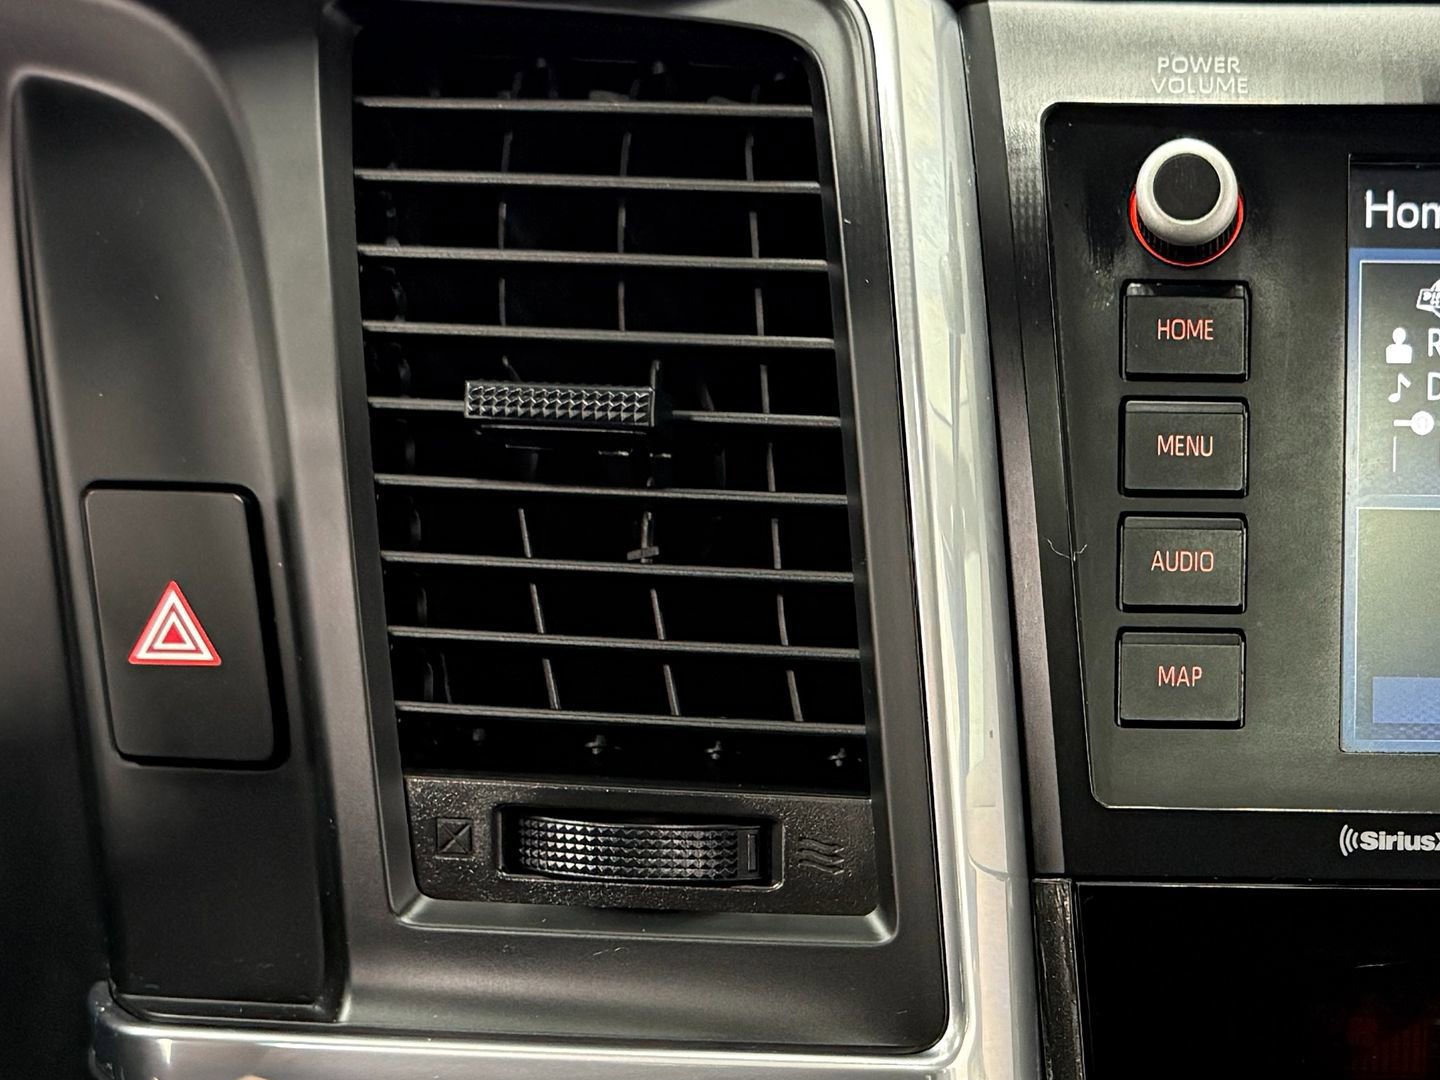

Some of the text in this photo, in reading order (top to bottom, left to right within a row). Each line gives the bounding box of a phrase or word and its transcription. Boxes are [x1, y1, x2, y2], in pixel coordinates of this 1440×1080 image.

[1157, 56, 1242, 74] POWER
[1150, 76, 1249, 95] VOLUME
[1157, 318, 1214, 341] HOME
[1157, 435, 1214, 458] MENU
[1150, 550, 1215, 573] AUDIO
[1158, 666, 1203, 687] MAP
